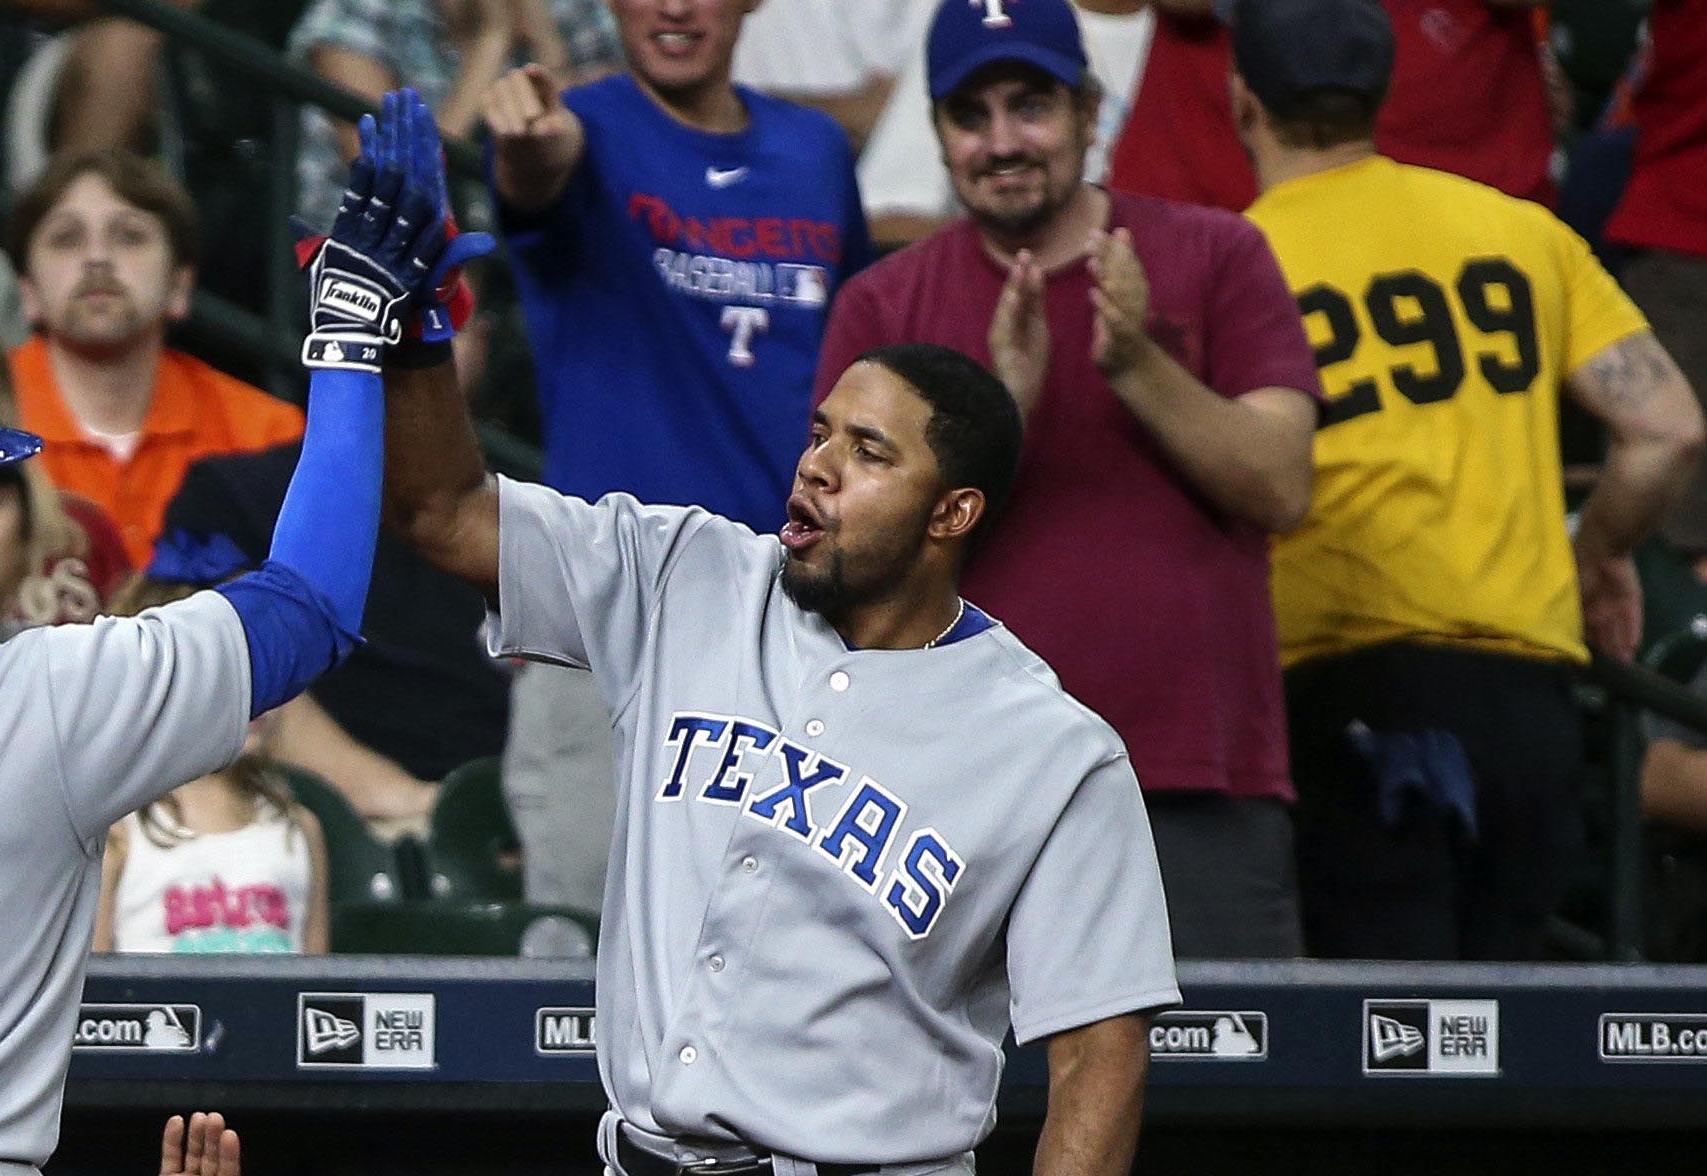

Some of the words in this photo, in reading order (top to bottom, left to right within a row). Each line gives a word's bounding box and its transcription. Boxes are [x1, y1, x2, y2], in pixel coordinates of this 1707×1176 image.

[429, 309, 443, 330] 1
[720, 305, 770, 367] T
[654, 710, 967, 940] TEXAS
[375, 1010, 423, 1030] NEW
[1442, 1015, 1488, 1035] NEW
[375, 1030, 423, 1051] ERA
[1442, 1035, 1488, 1057] ERA
